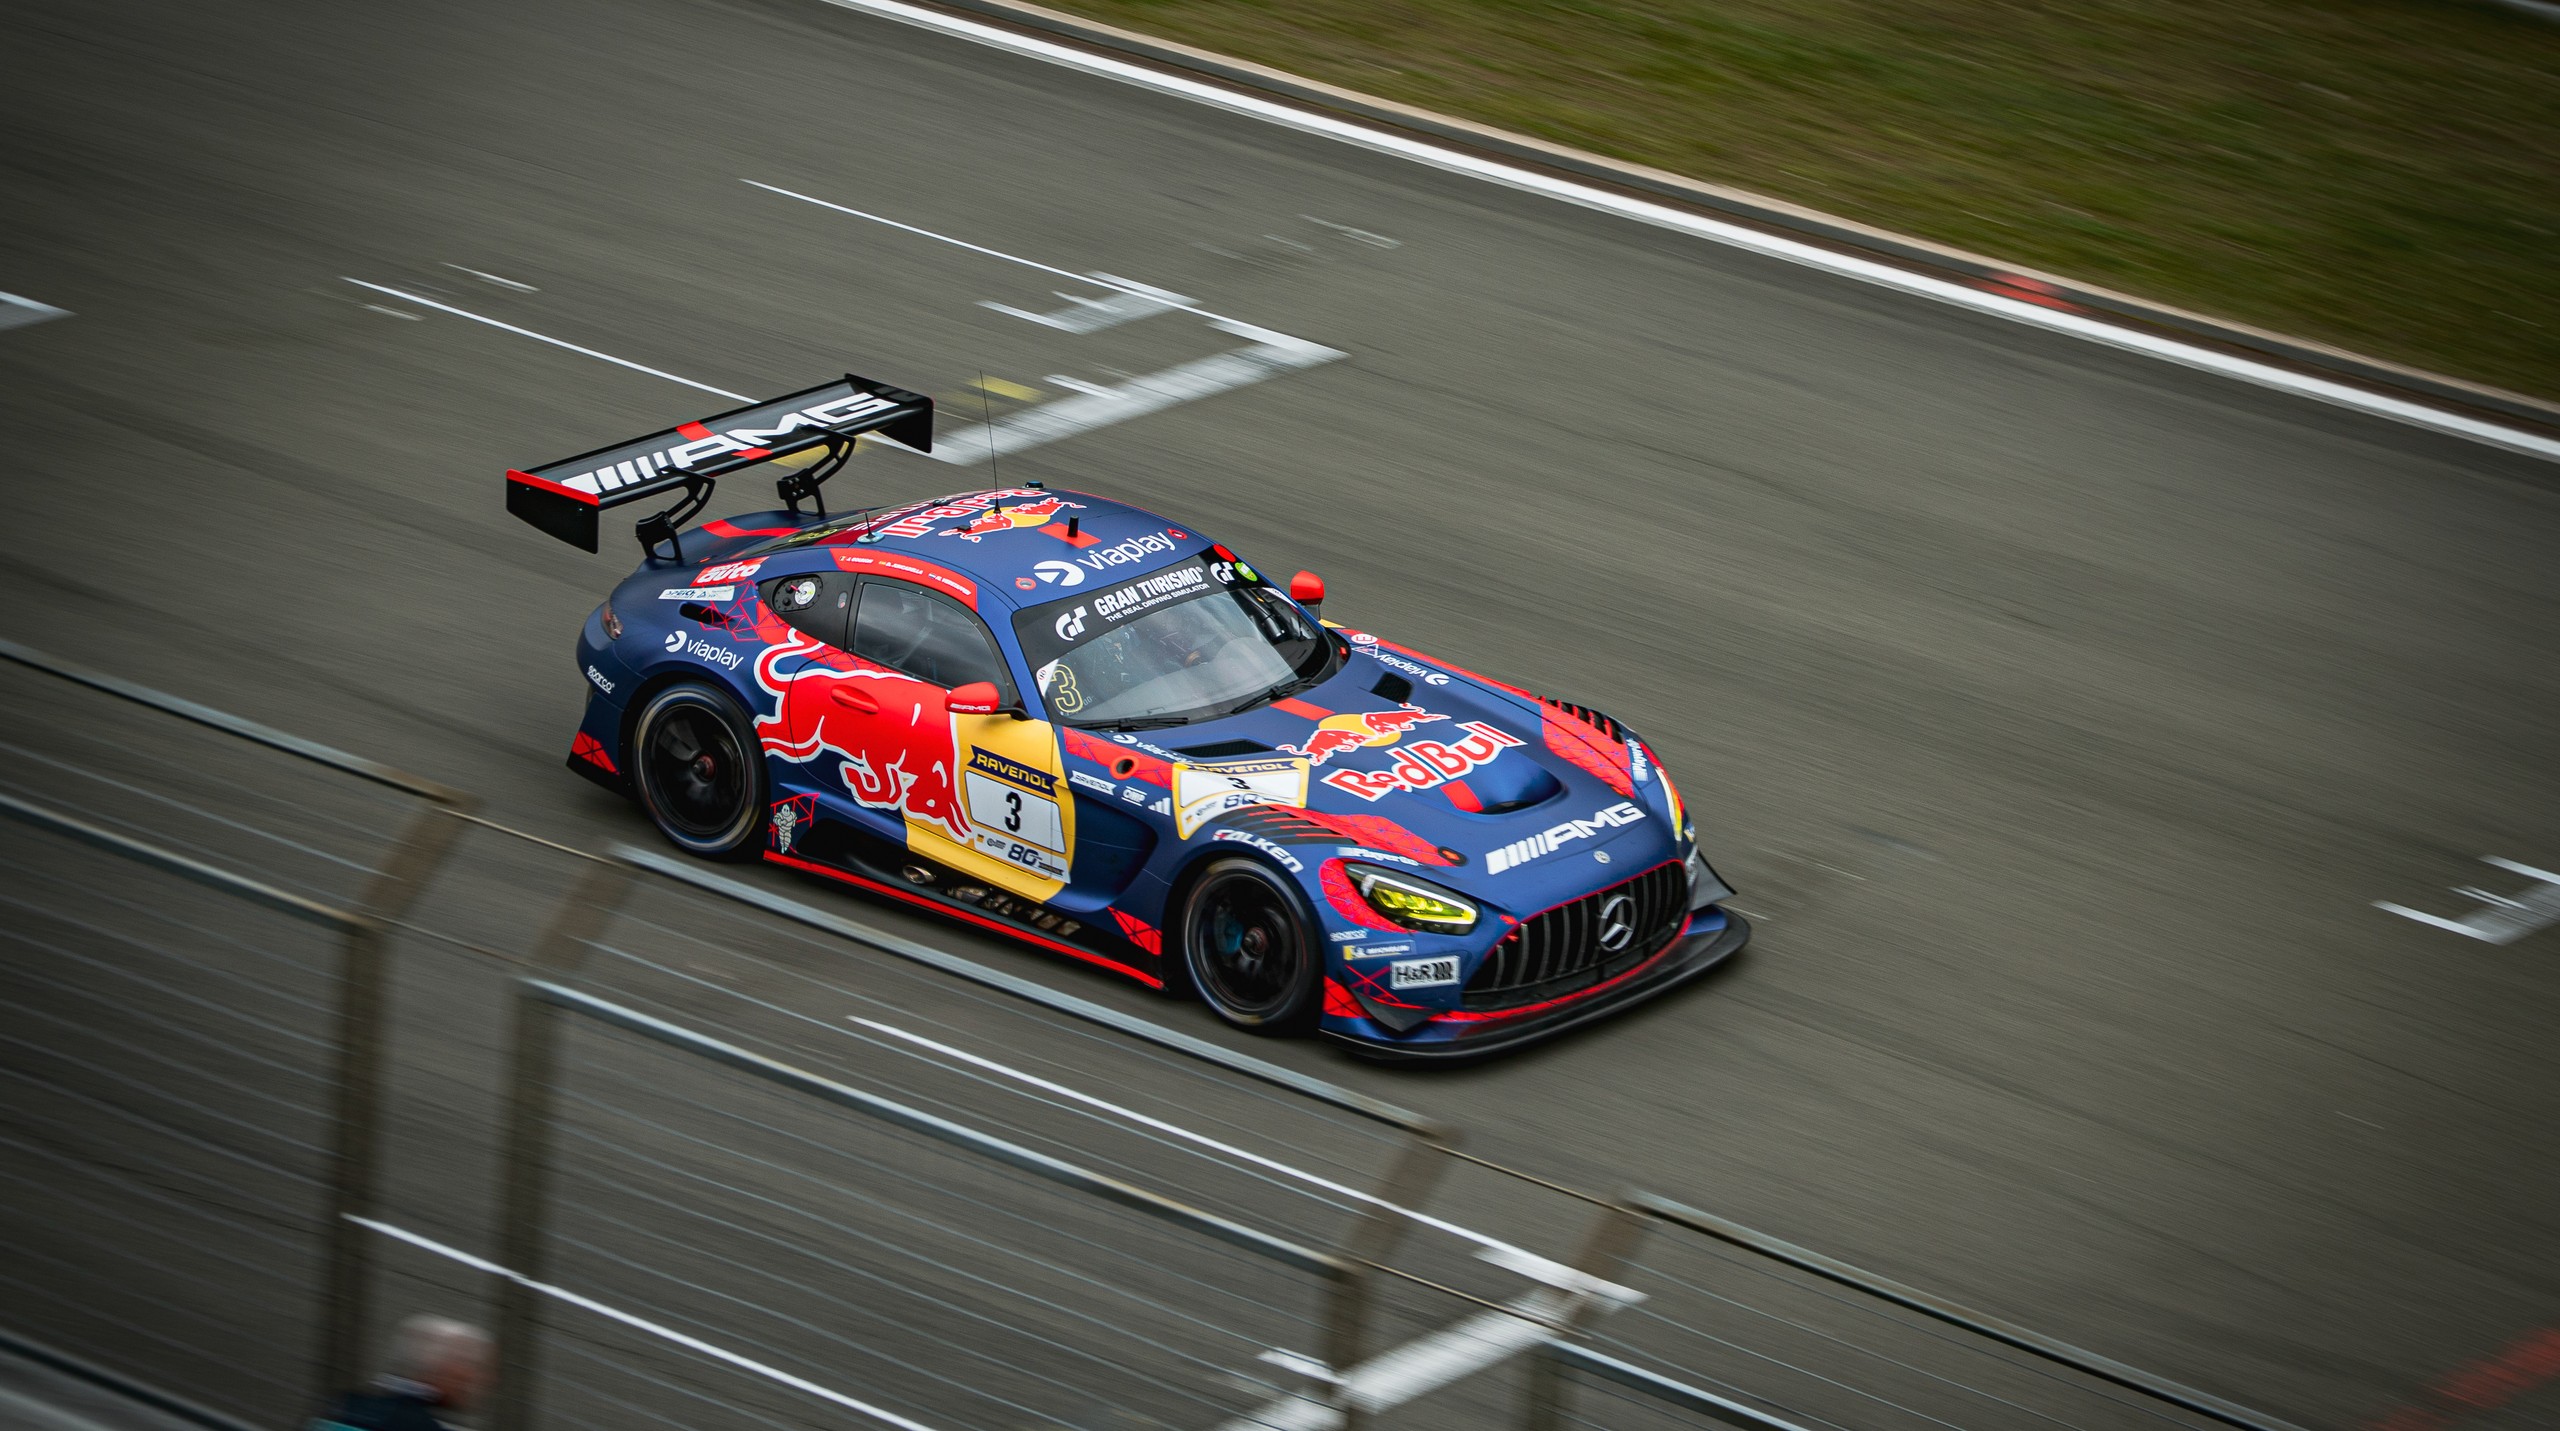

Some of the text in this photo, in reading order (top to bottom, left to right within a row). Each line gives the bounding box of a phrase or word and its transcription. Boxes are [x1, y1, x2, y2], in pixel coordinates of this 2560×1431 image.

[666, 392, 899, 468] AMG
[879, 503, 980, 539] Bull
[1076, 531, 1176, 571] viaplay
[697, 564, 761, 583] auto
[1094, 566, 1203, 617] GRAN TURISMO
[1105, 583, 1211, 623] THE REAL DRIVING SIMULATOR
[687, 639, 744, 671] viaplay
[1377, 654, 1428, 677] viaplay
[587, 665, 613, 693] sparco
[1050, 664, 1084, 713] 3
[976, 754, 1051, 790] RAVENOL
[1320, 721, 1527, 802] Red Bull
[1075, 774, 1110, 791] RAVENOL
[1226, 777, 1251, 789] 3
[1004, 791, 1022, 833] 3
[1545, 802, 1647, 852] AMG
[1212, 829, 1304, 874] FALKEN
